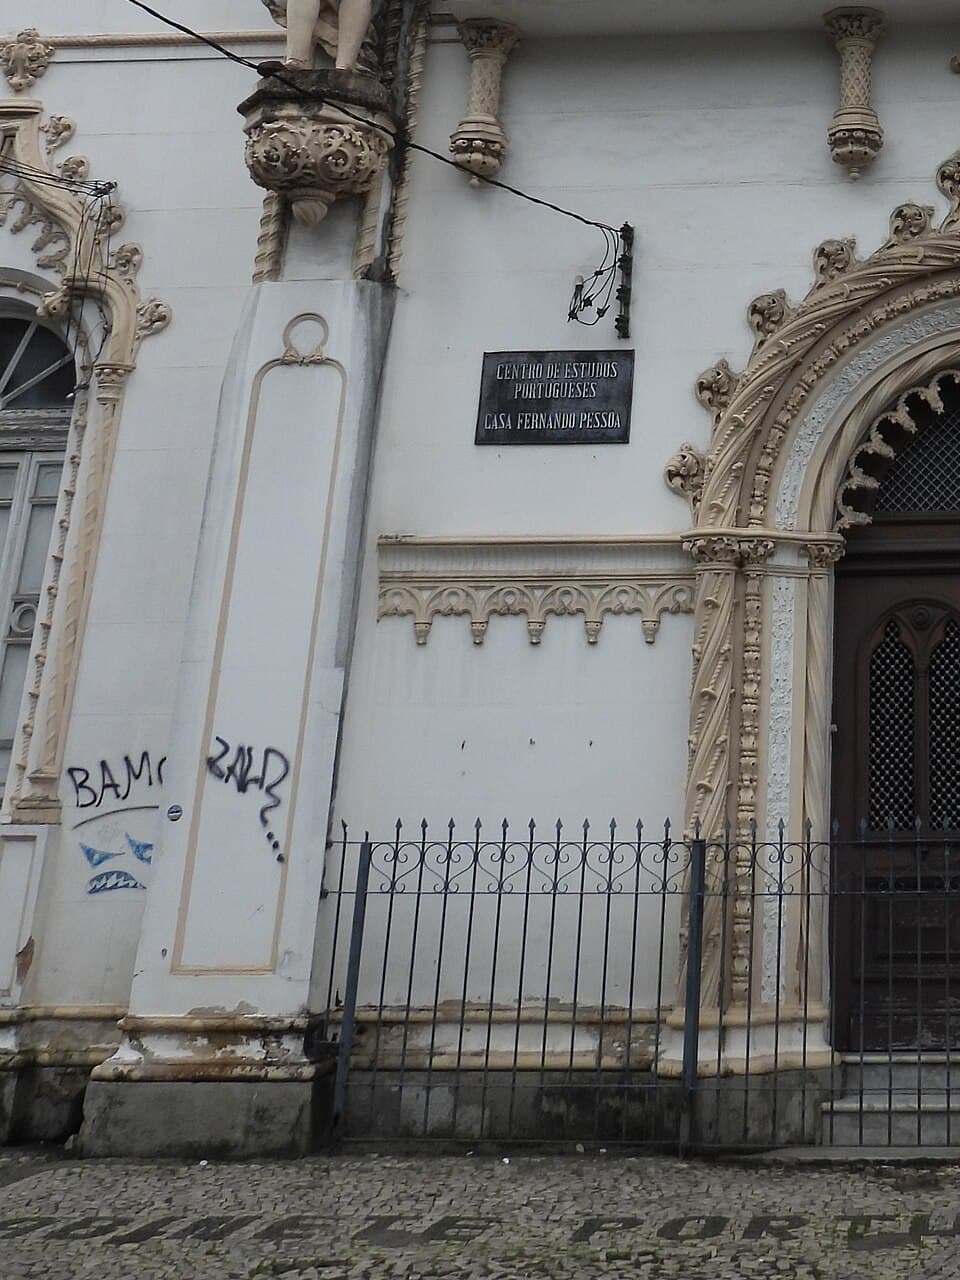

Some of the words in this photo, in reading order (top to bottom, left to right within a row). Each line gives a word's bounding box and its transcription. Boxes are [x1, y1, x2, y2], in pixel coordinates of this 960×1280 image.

[496, 362, 543, 380] CENTRO
[546, 362, 560, 379] DE
[564, 361, 618, 378] ESTUDOS
[514, 382, 597, 399] PORTUGUESES
[484, 412, 512, 429] CASA
[517, 411, 576, 429] FERNANDO
[579, 411, 621, 429] PESSOA
